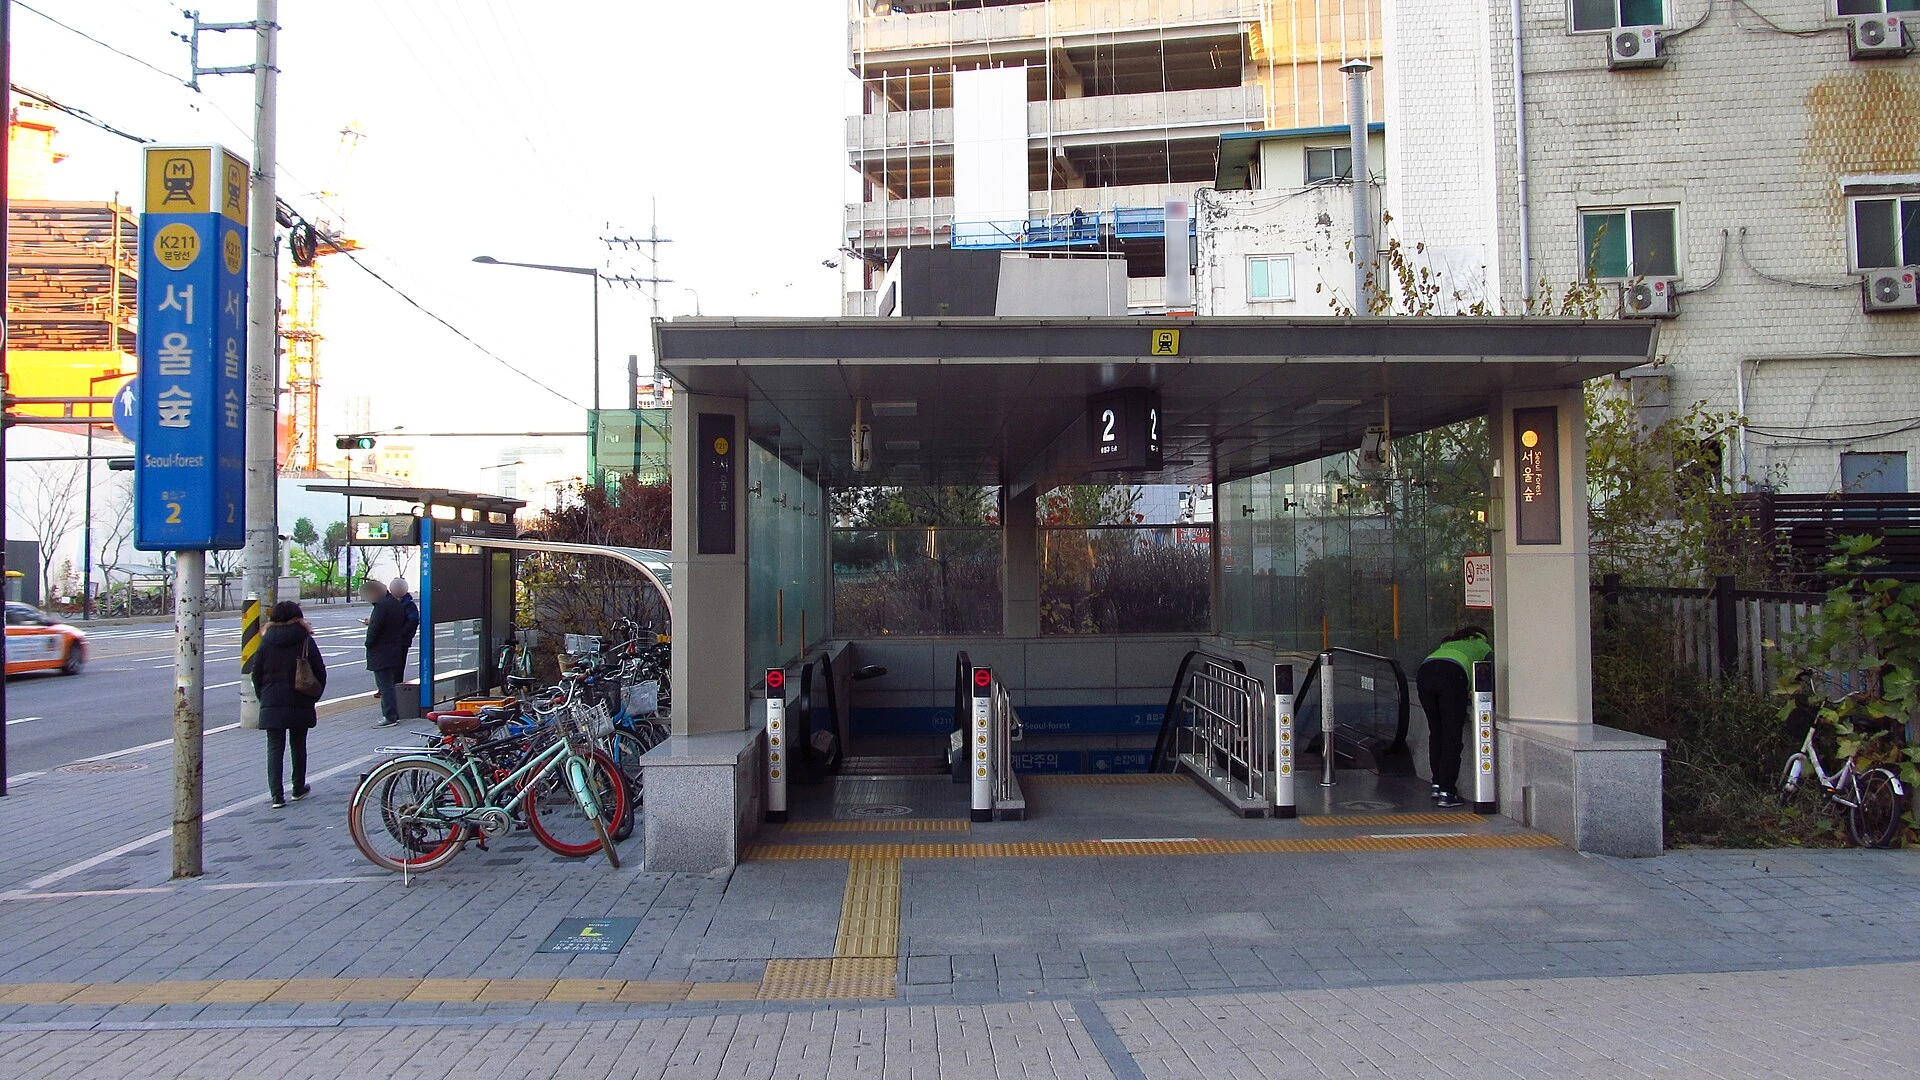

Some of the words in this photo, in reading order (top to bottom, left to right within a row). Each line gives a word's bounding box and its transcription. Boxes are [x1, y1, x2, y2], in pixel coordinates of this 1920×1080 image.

[173, 164, 185, 175] M
[160, 236, 195, 249] K211
[164, 251, 190, 261] 분당선
[158, 284, 194, 428] 서울숲
[225, 289, 240, 429] 서울숲
[1102, 409, 1115, 441] 2
[1150, 408, 1157, 440] 2
[145, 453, 203, 468] Seoul-forest
[1534, 451, 1542, 472] Seoul
[1522, 450, 1534, 502] 서울숲
[165, 503, 181, 523] 2
[227, 503, 235, 523] 2
[1025, 721, 1071, 730] Seoul-forest
[1011, 753, 1058, 769] 계단주의
